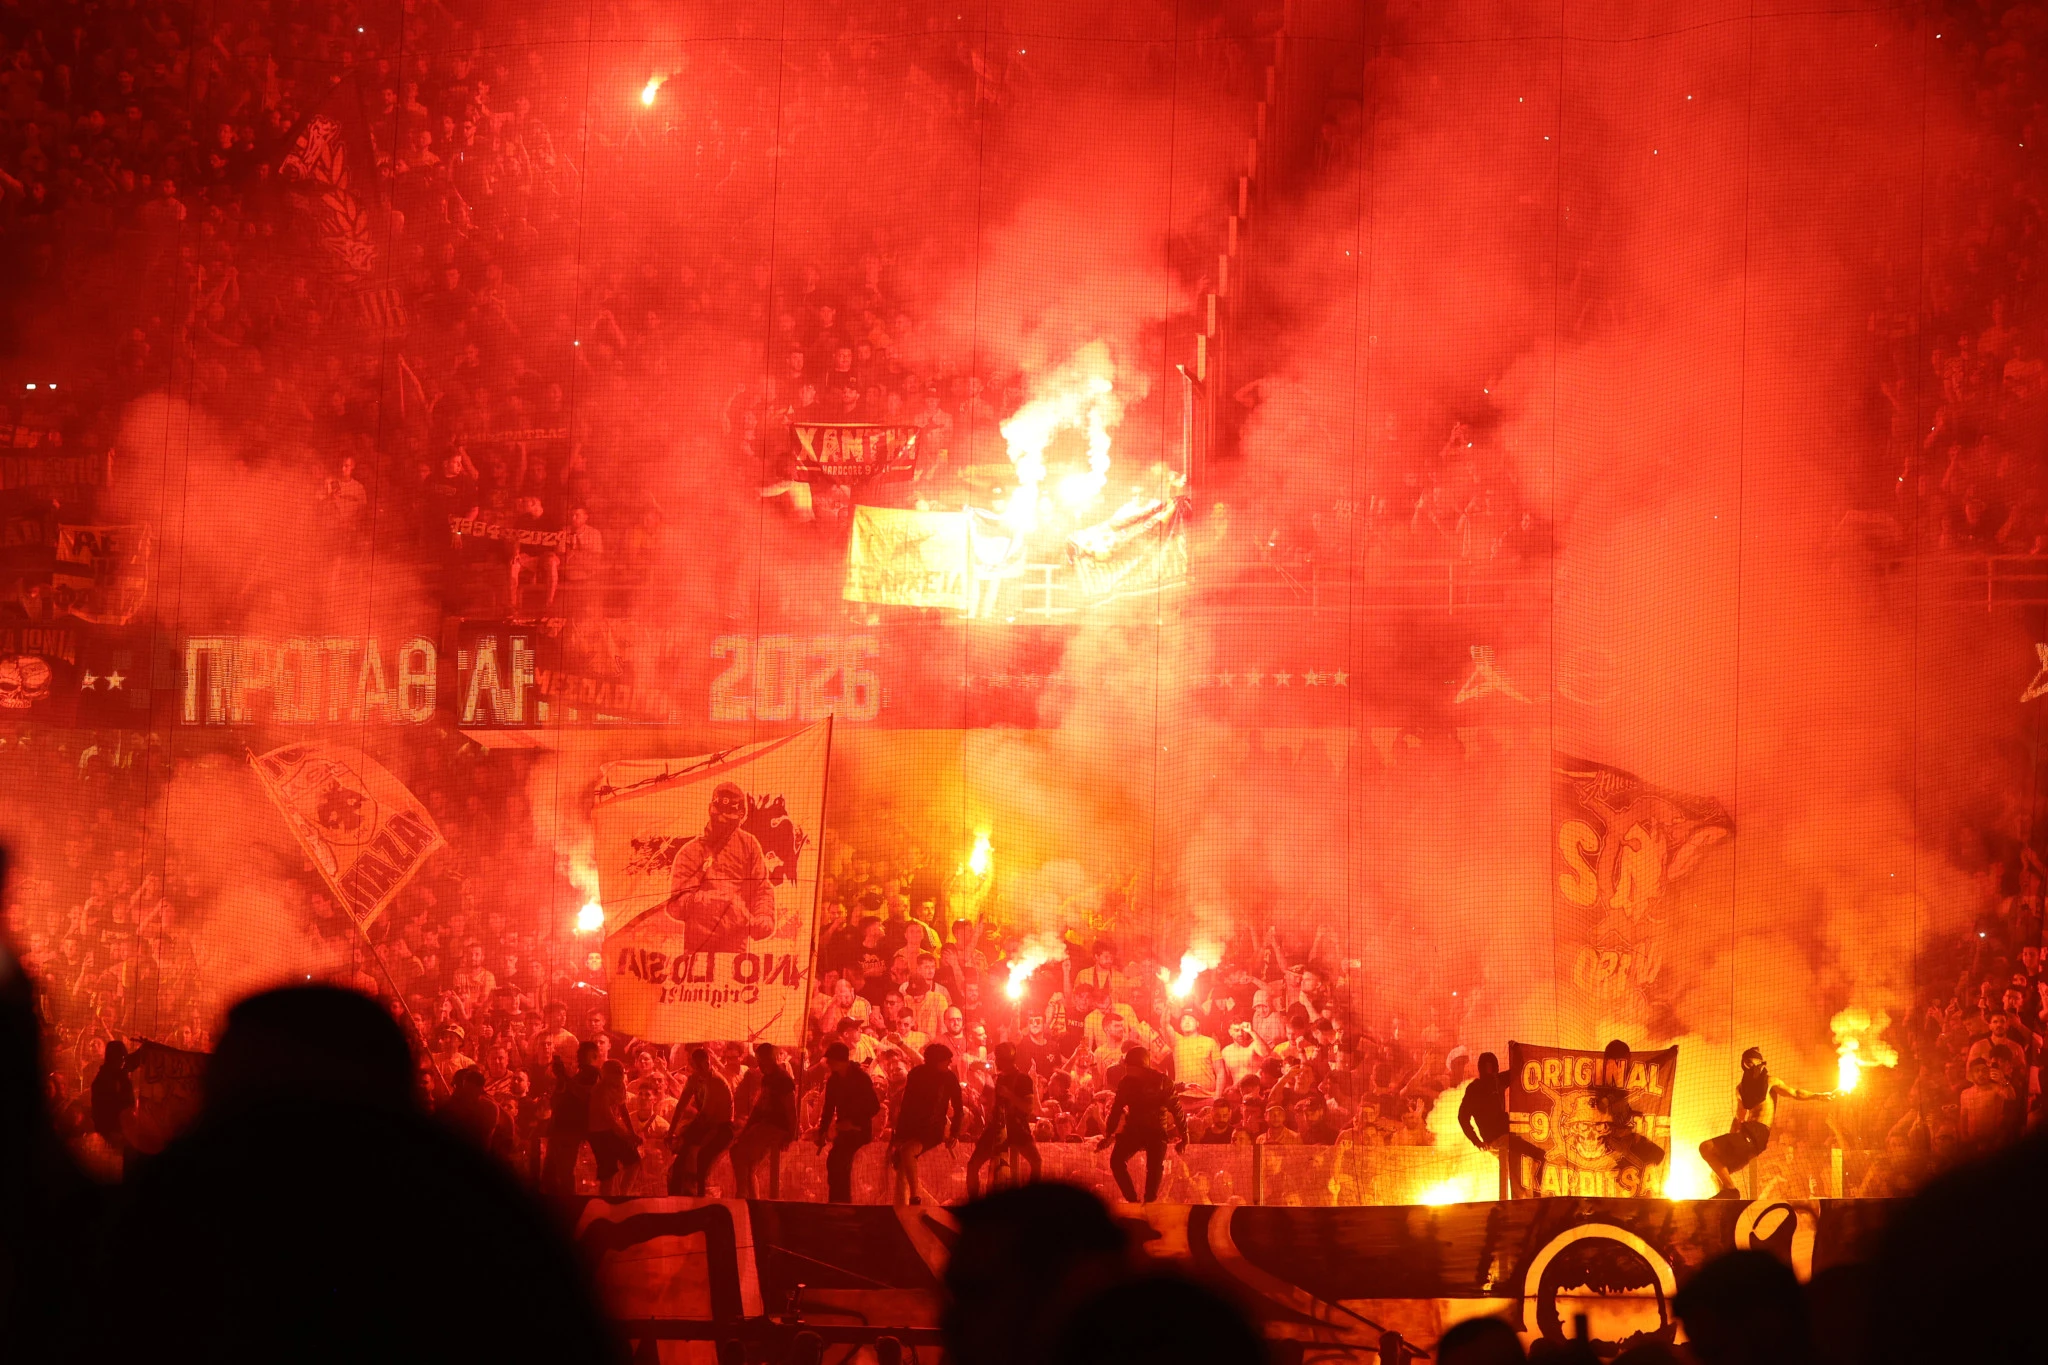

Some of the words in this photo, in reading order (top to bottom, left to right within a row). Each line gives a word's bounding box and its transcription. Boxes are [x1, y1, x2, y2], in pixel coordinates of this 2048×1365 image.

[709, 634, 880, 721] 2026
[1522, 1056, 1663, 1096] ORIGINAL
[1529, 1111, 1549, 1142] 9
[1520, 1154, 1663, 1197] KARDITSA
